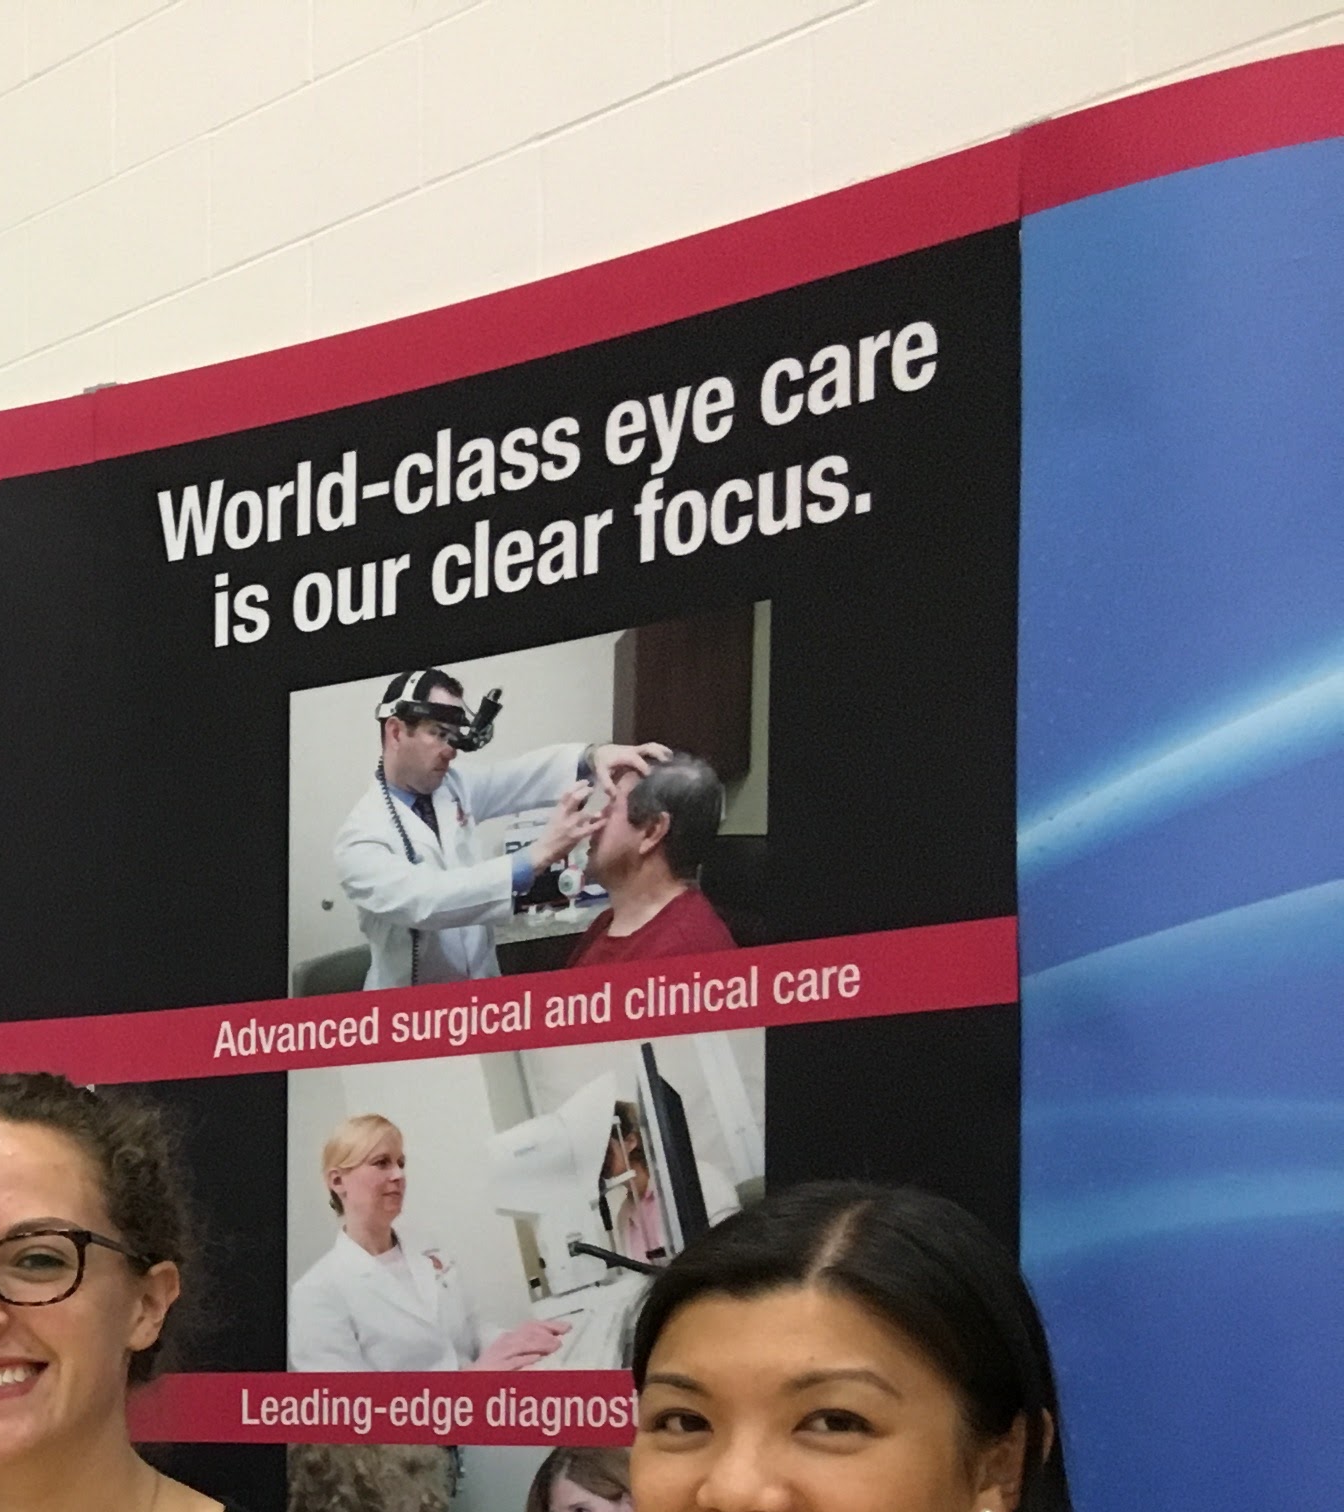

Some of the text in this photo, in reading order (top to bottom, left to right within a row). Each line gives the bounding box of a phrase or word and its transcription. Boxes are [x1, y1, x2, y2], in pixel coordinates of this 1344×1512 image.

[158, 320, 939, 563] World-class eye care
[214, 454, 873, 648] is our clear focus.
[213, 959, 861, 1059] Advanced surgical and clinical care
[241, 1387, 640, 1435] Leading-edge diagnost
